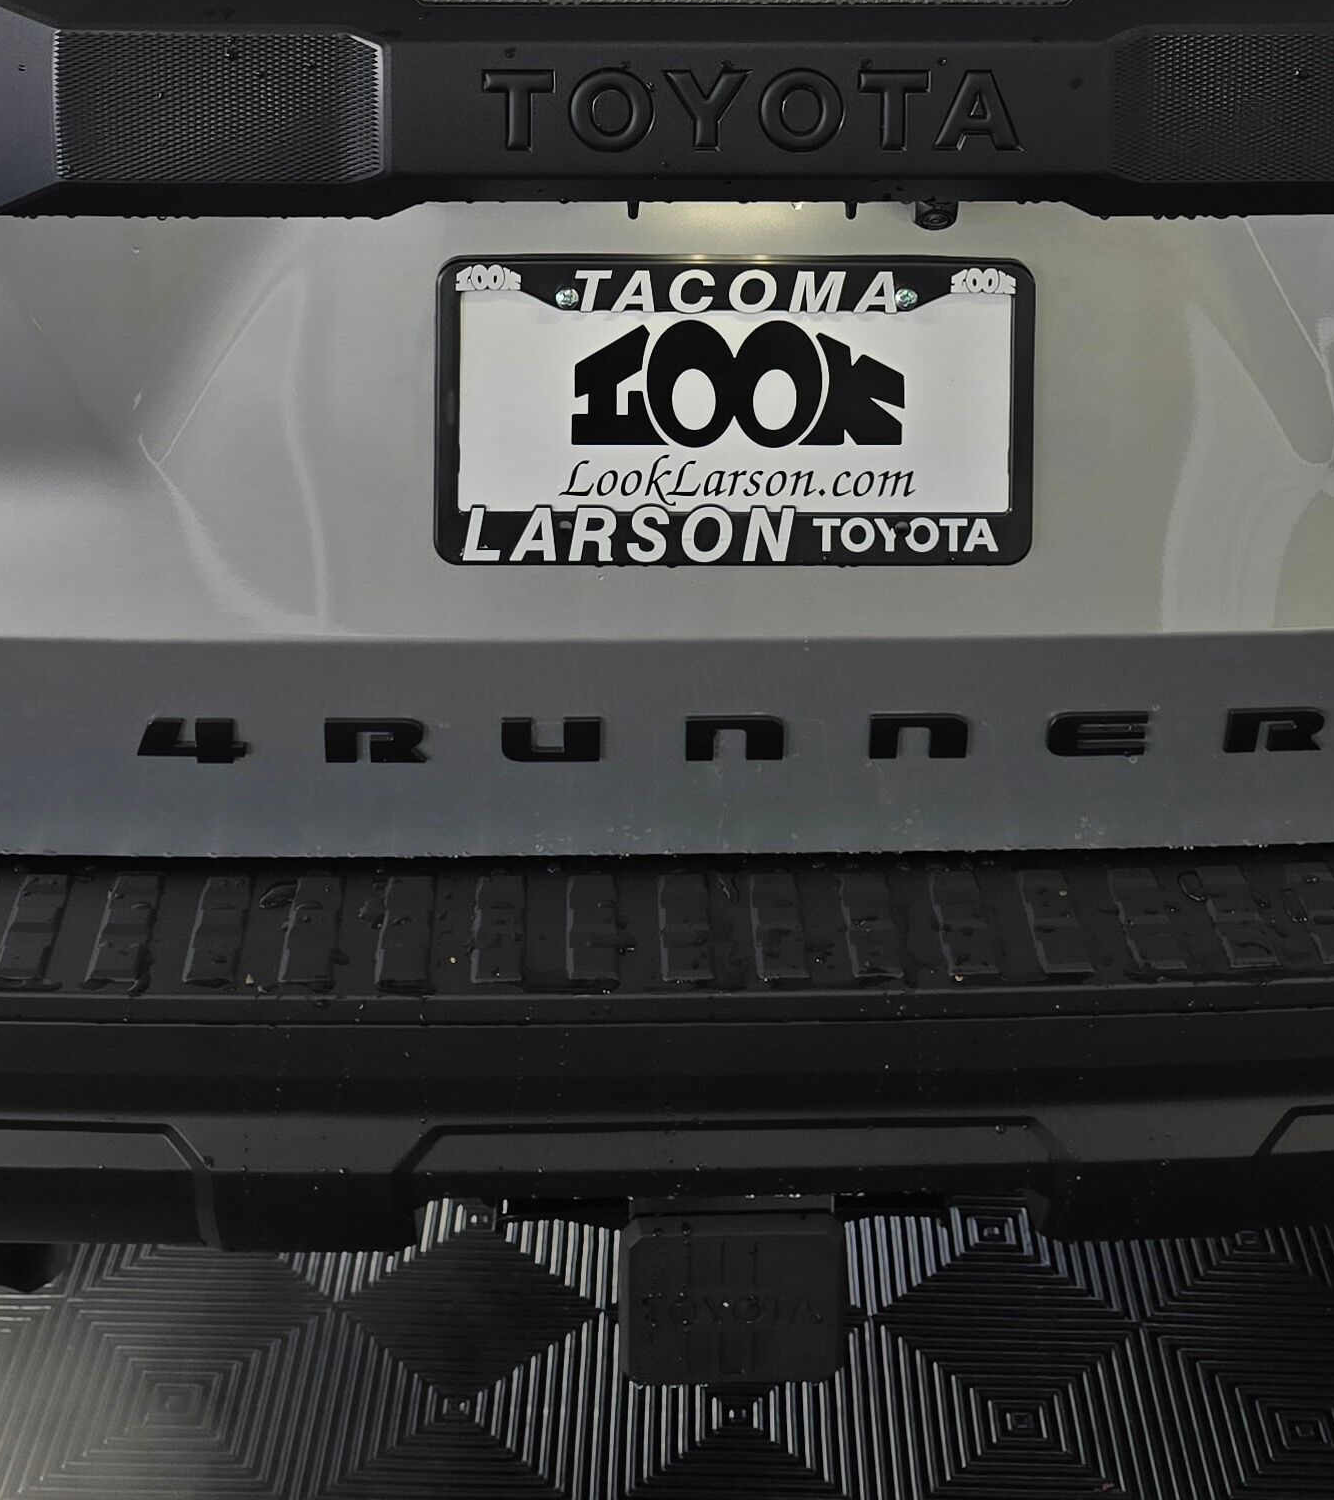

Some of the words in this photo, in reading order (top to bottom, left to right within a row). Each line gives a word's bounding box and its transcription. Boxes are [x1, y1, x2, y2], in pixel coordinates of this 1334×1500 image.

[481, 67, 1024, 152] TOYOTA
[575, 269, 898, 314] TACOMA
[571, 319, 905, 448] LOOK
[559, 454, 917, 506] LookLarson.com
[461, 505, 796, 563] LARSON
[812, 517, 999, 553] TOYOTA
[135, 705, 1327, 765] 4RUNNER
